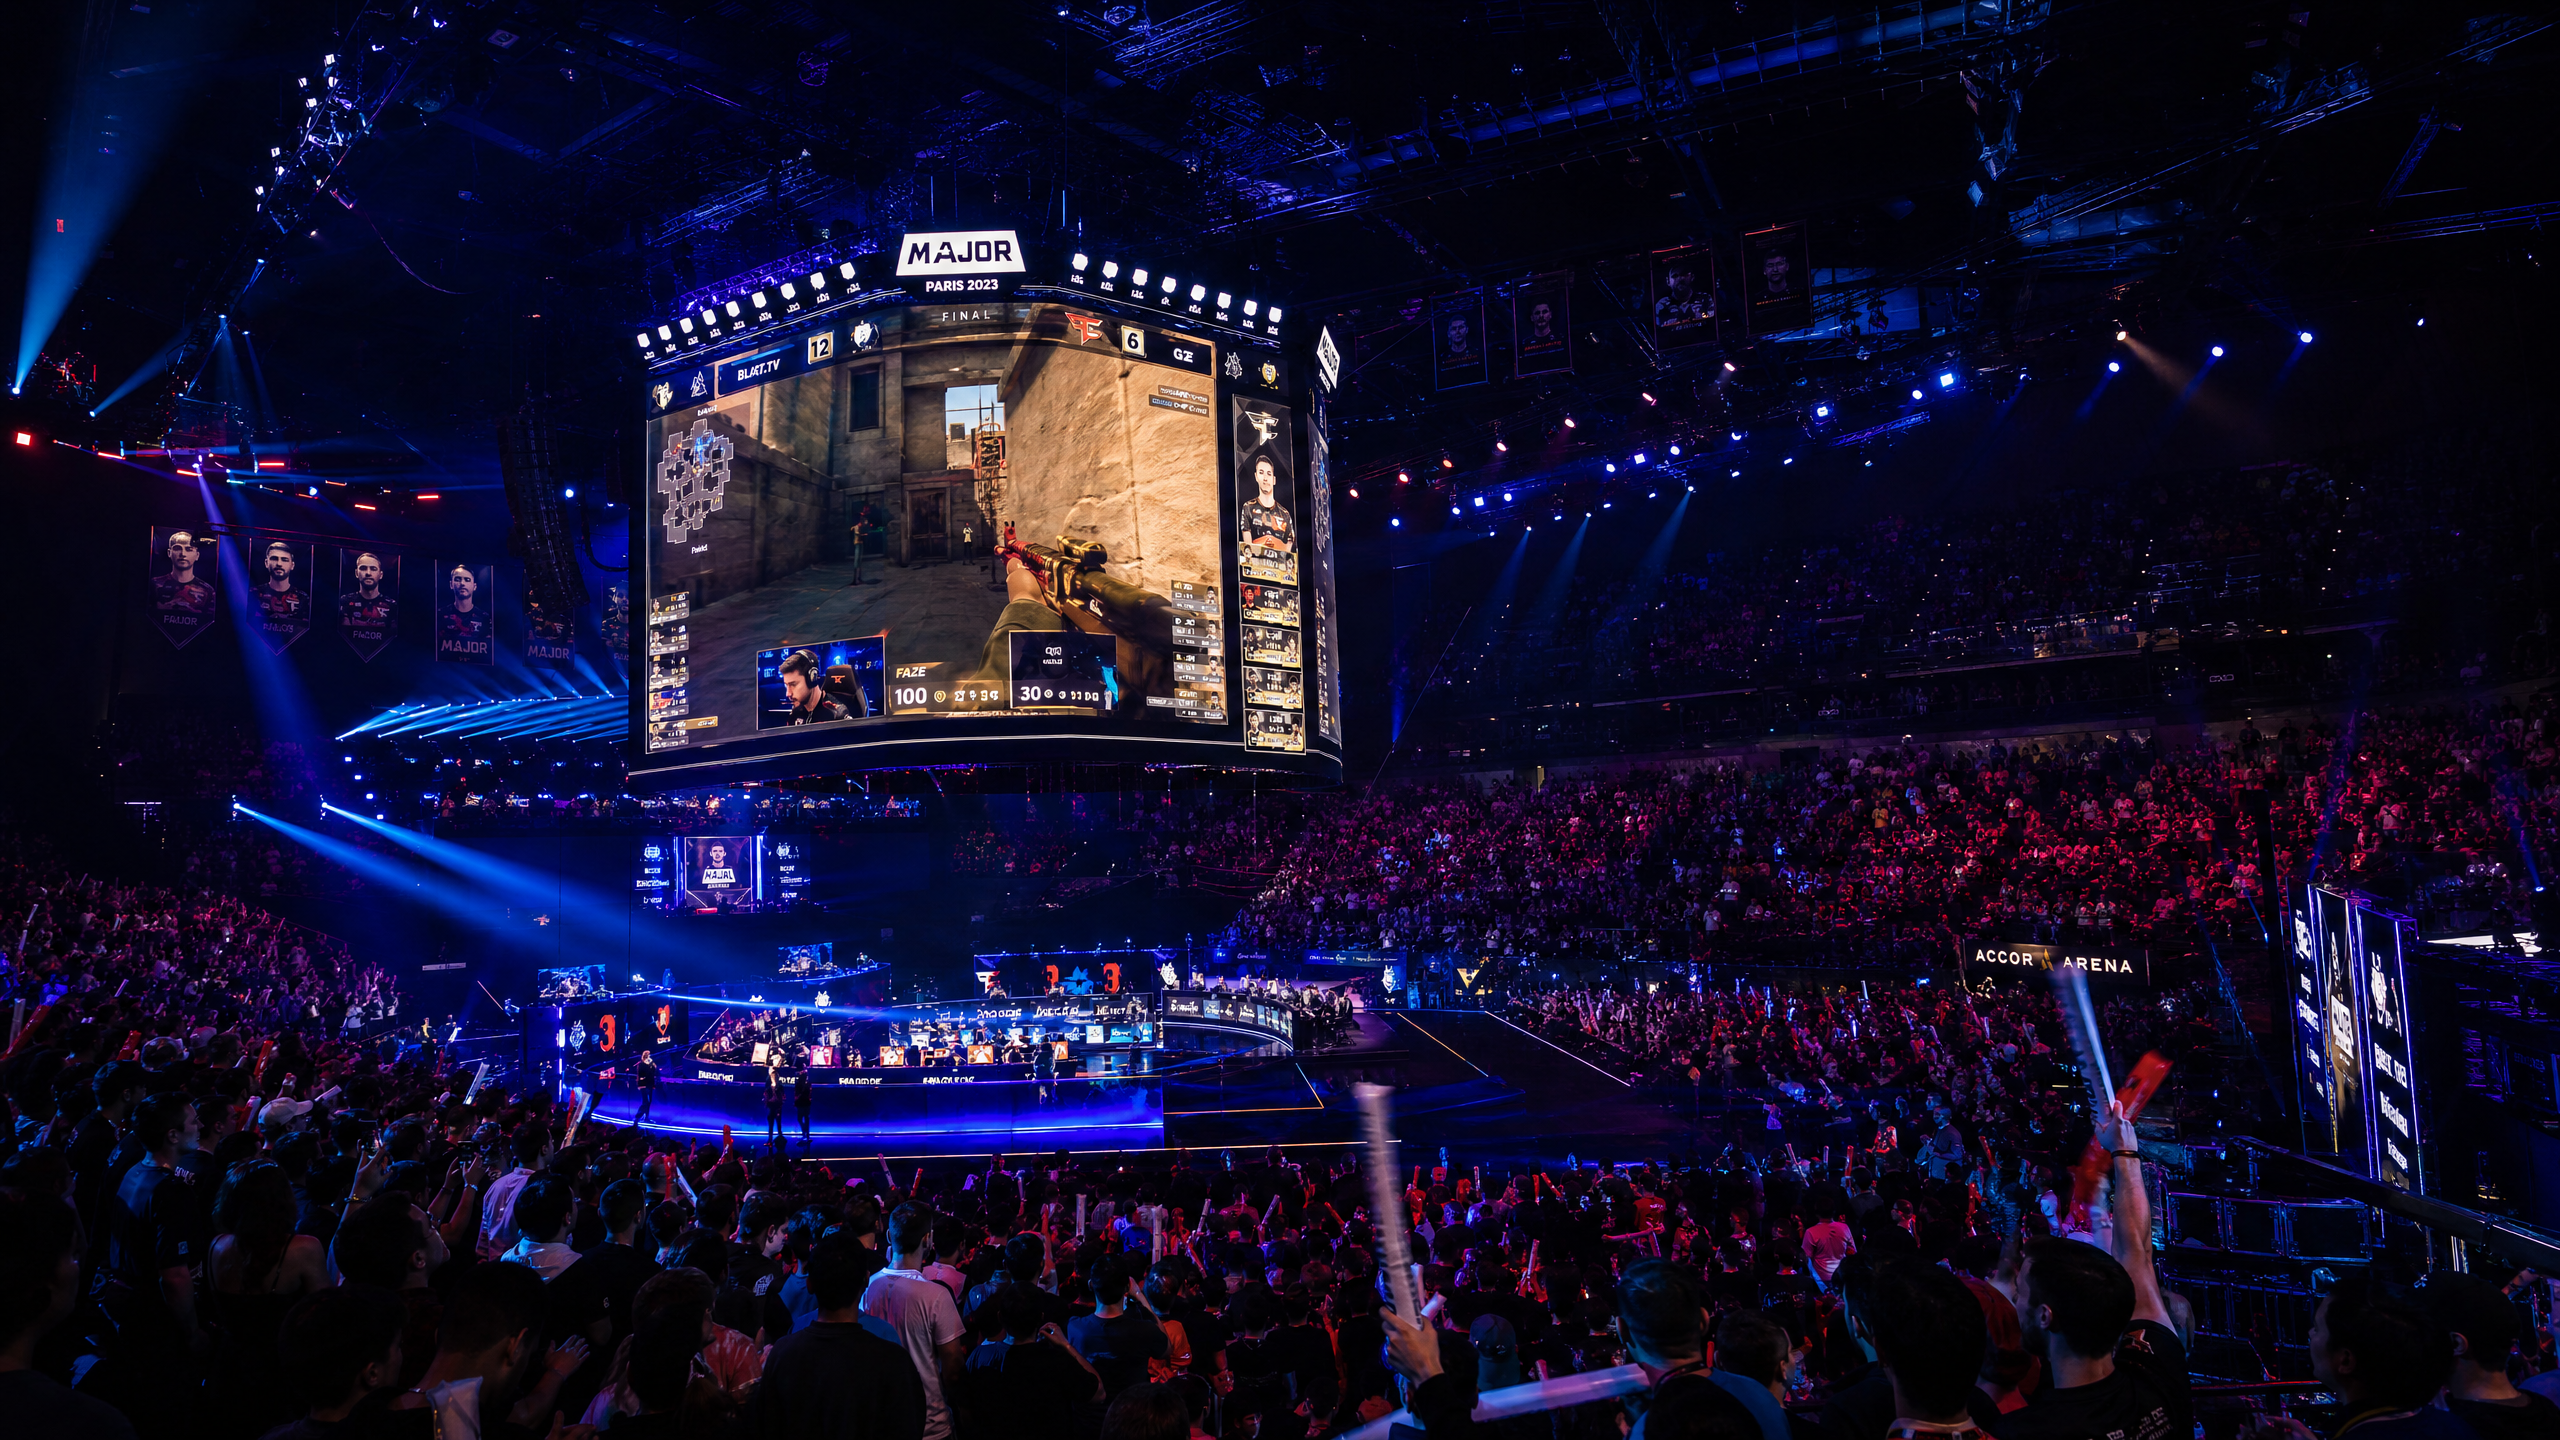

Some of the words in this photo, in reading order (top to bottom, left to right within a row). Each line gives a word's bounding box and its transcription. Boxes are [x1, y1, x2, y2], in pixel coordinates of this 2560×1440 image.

[907, 240, 1013, 265] MAJOR
[925, 281, 964, 292] PARIS
[967, 279, 999, 291] 2023
[942, 310, 991, 322] FINAL
[811, 338, 829, 358] 12
[1127, 332, 1139, 350] 6
[440, 639, 488, 654] MAJOR
[528, 645, 570, 660] MAJOR
[896, 666, 926, 679] FAZE
[894, 687, 928, 706] 100
[1020, 686, 1041, 701] 30
[1975, 949, 2033, 966] ACCOR
[2063, 956, 2133, 974] ARENA
